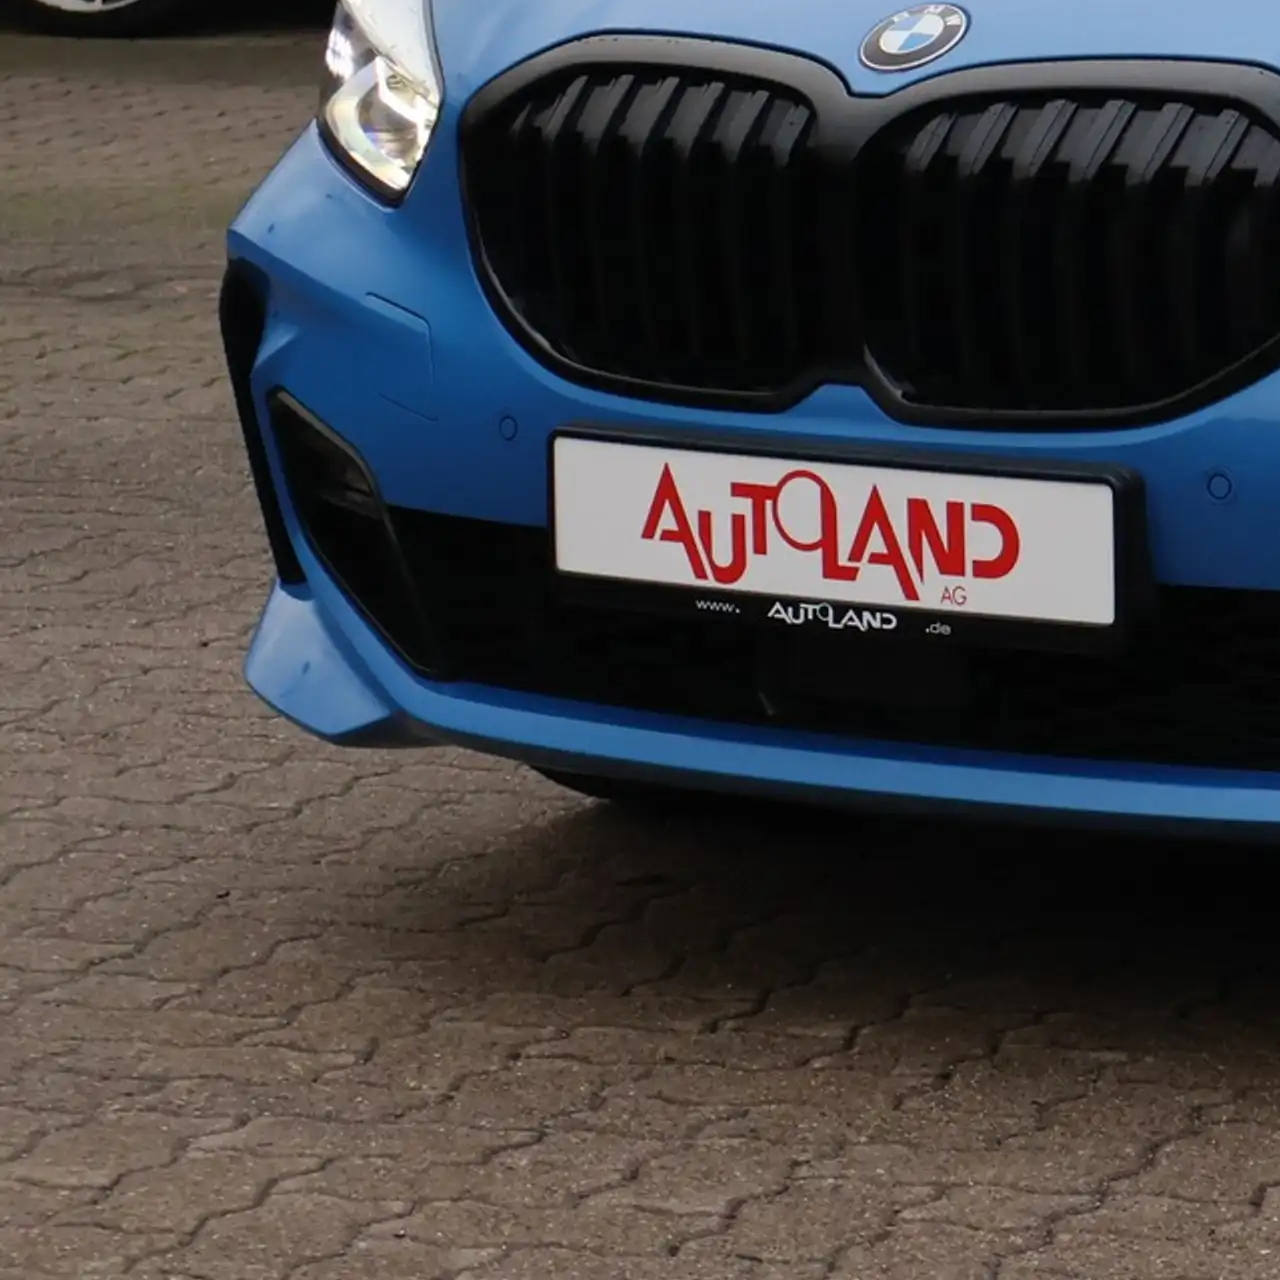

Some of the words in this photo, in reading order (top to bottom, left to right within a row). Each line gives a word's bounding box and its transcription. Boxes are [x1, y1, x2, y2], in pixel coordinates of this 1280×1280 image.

[641, 462, 1019, 601] AUTOLAND
[939, 585, 968, 606] AG
[767, 601, 898, 632] AUTOLAND
